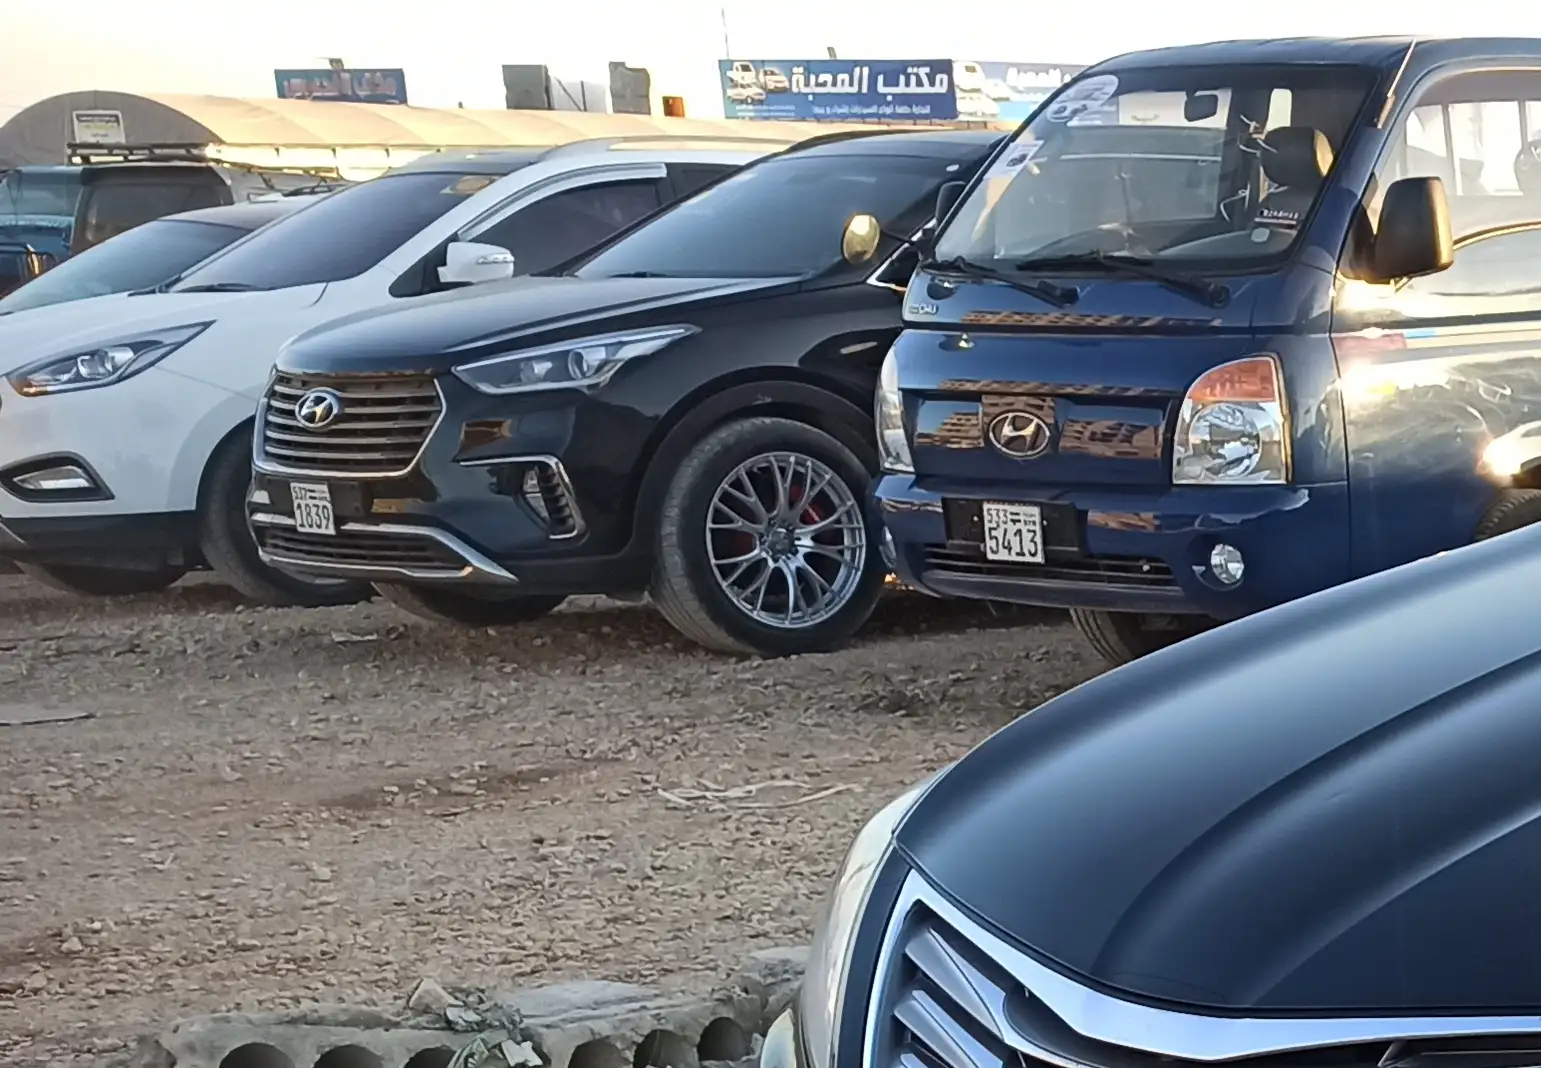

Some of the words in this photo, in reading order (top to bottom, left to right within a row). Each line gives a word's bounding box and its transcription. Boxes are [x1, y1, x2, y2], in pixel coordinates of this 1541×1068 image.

[791, 66, 870, 101] المحبة
[877, 67, 949, 101] مكتب
[296, 502, 331, 530] 1839
[987, 527, 1039, 558] 5413
